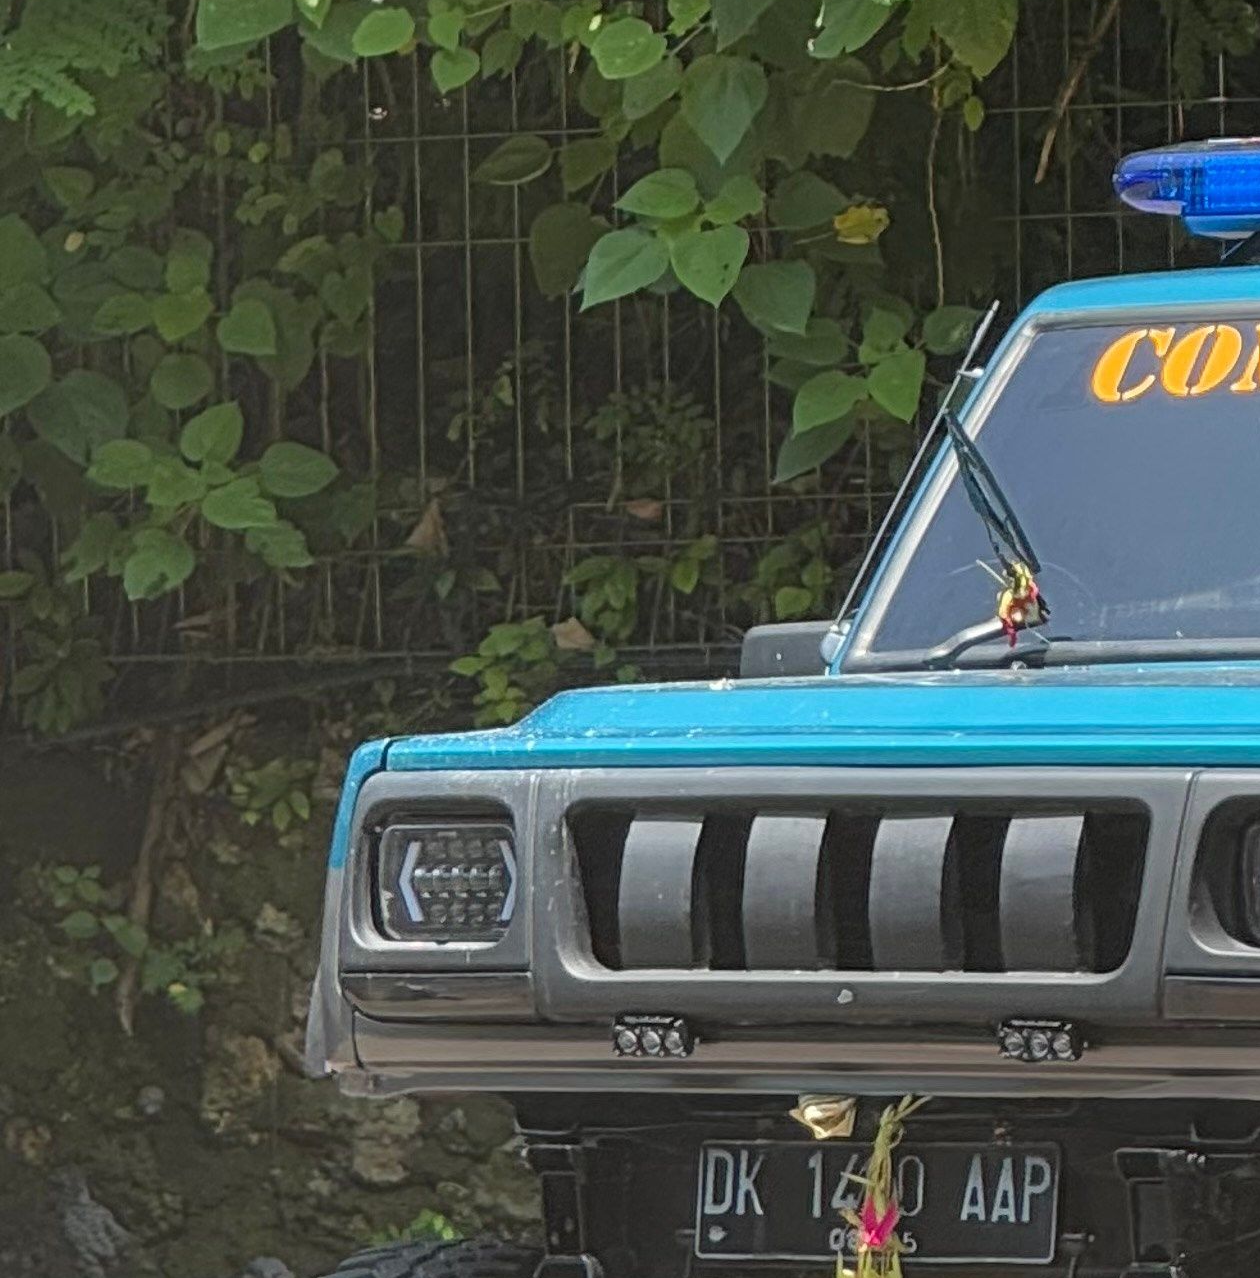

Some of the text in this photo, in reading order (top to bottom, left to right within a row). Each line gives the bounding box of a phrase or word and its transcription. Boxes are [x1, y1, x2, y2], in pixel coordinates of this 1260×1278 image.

[703, 1149, 1052, 1223] DK 140 AAP
